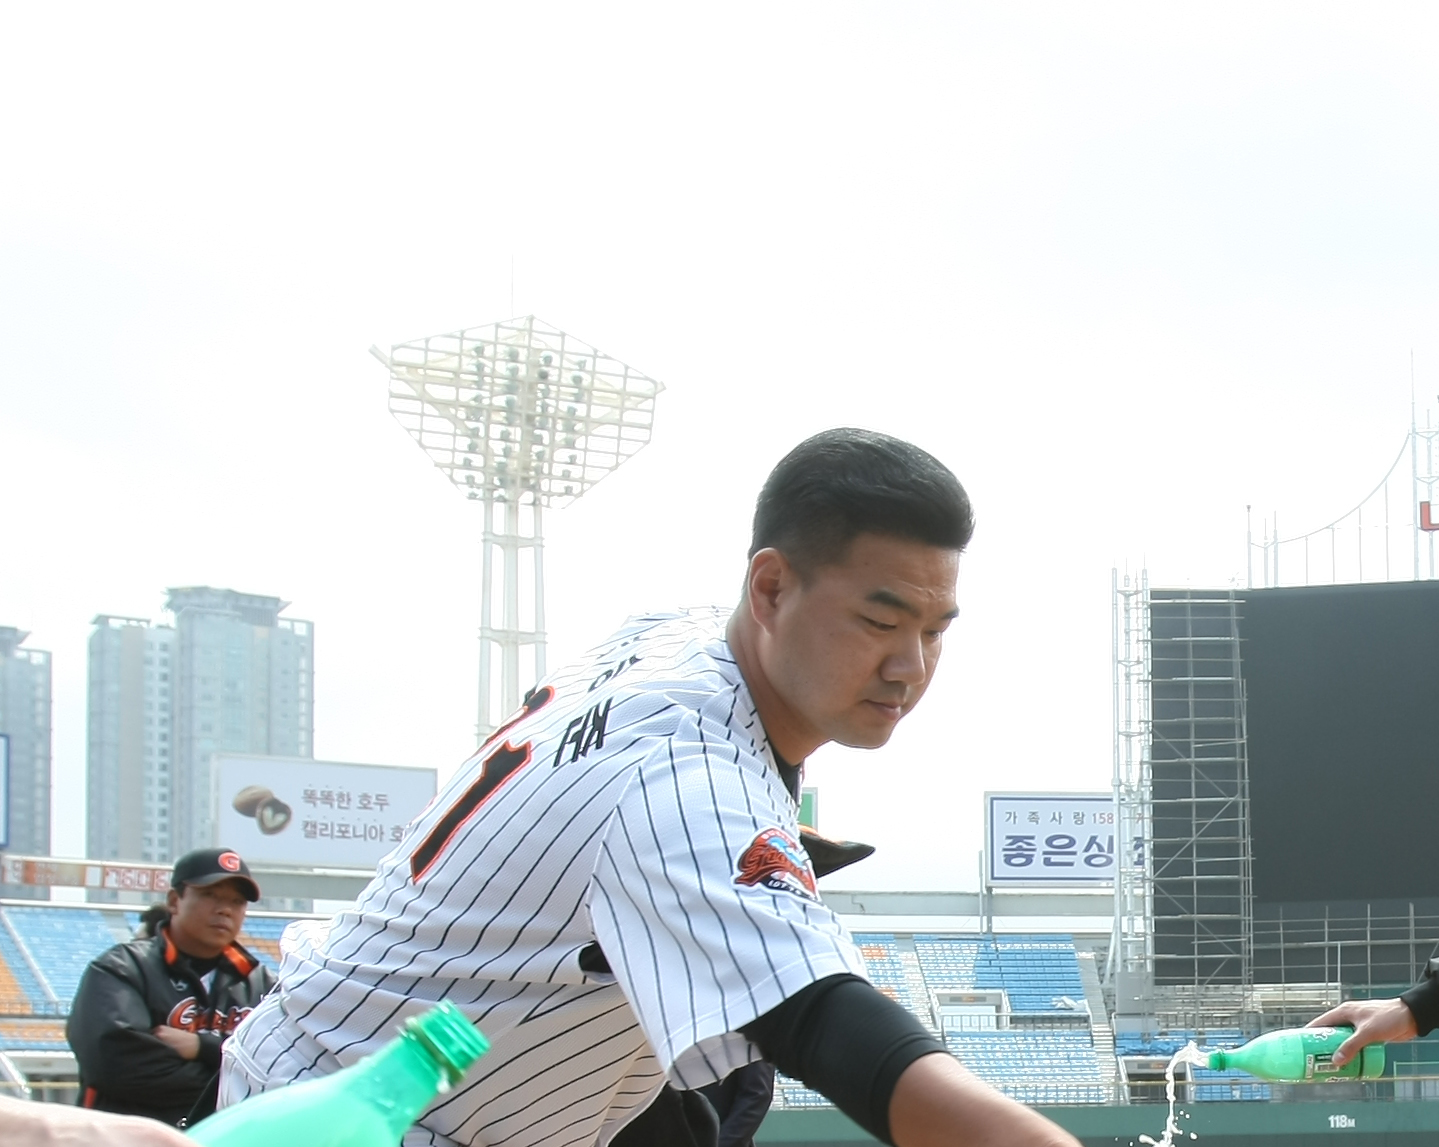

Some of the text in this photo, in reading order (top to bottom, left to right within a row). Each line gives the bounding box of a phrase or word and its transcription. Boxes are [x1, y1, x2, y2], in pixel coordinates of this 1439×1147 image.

[357, 793, 389, 811] 호두
[302, 821, 405, 842] 캘리포니아 호
[218, 852, 241, 872] G
